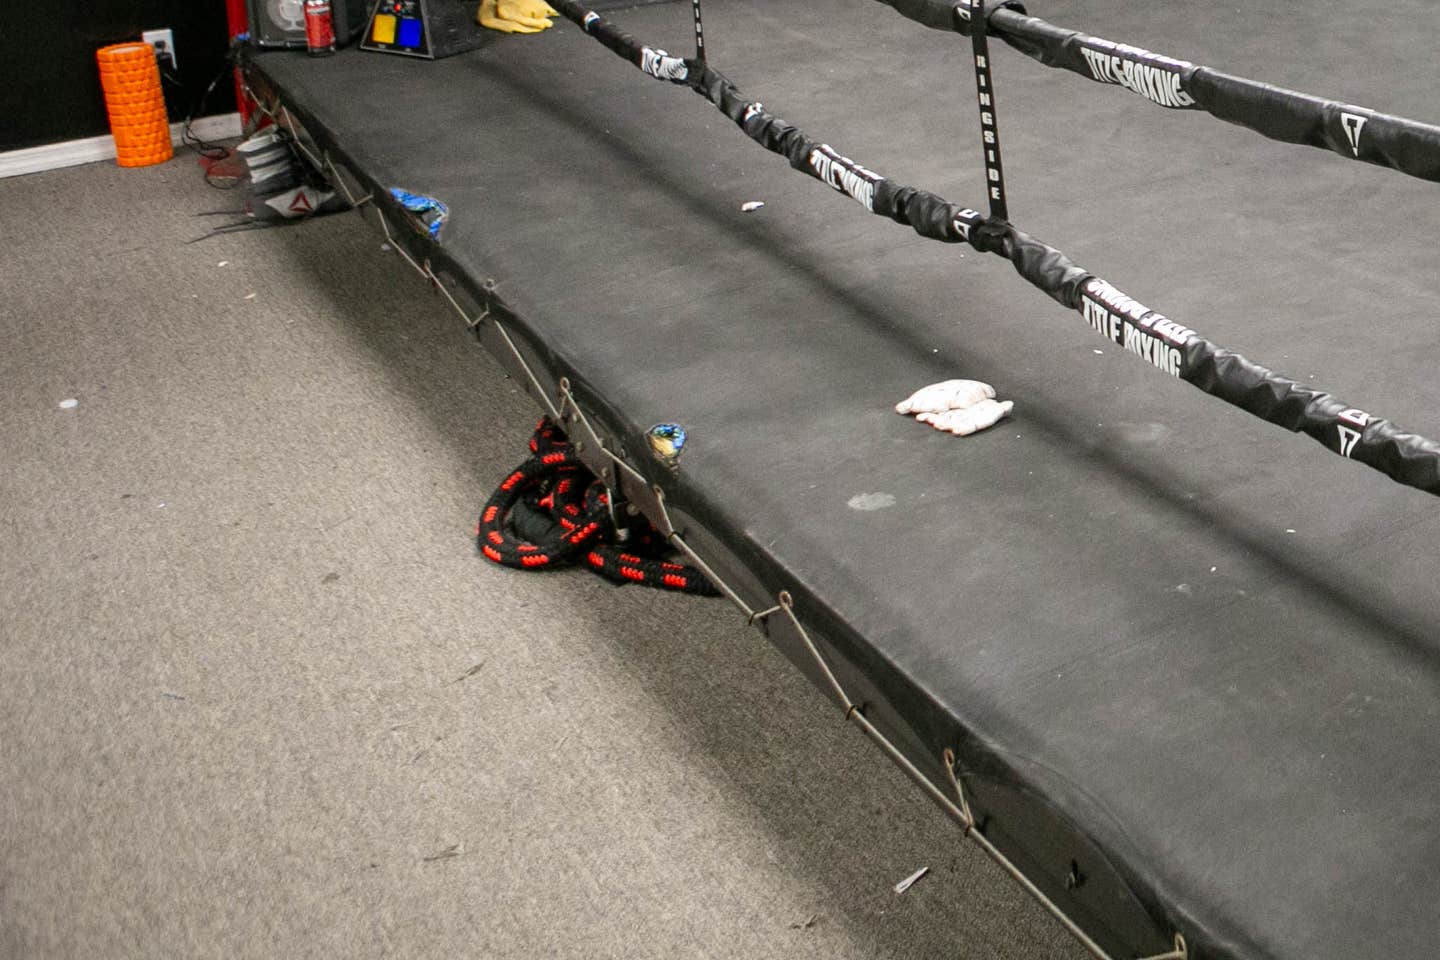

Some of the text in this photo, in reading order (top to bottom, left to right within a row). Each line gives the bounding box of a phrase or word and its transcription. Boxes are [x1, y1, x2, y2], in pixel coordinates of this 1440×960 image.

[1080, 46, 1196, 107] TITLE BOXING
[977, 54, 1001, 200] RINGSIDE
[1081, 294, 1122, 344] TITLE
[1122, 319, 1183, 378] BOXING
